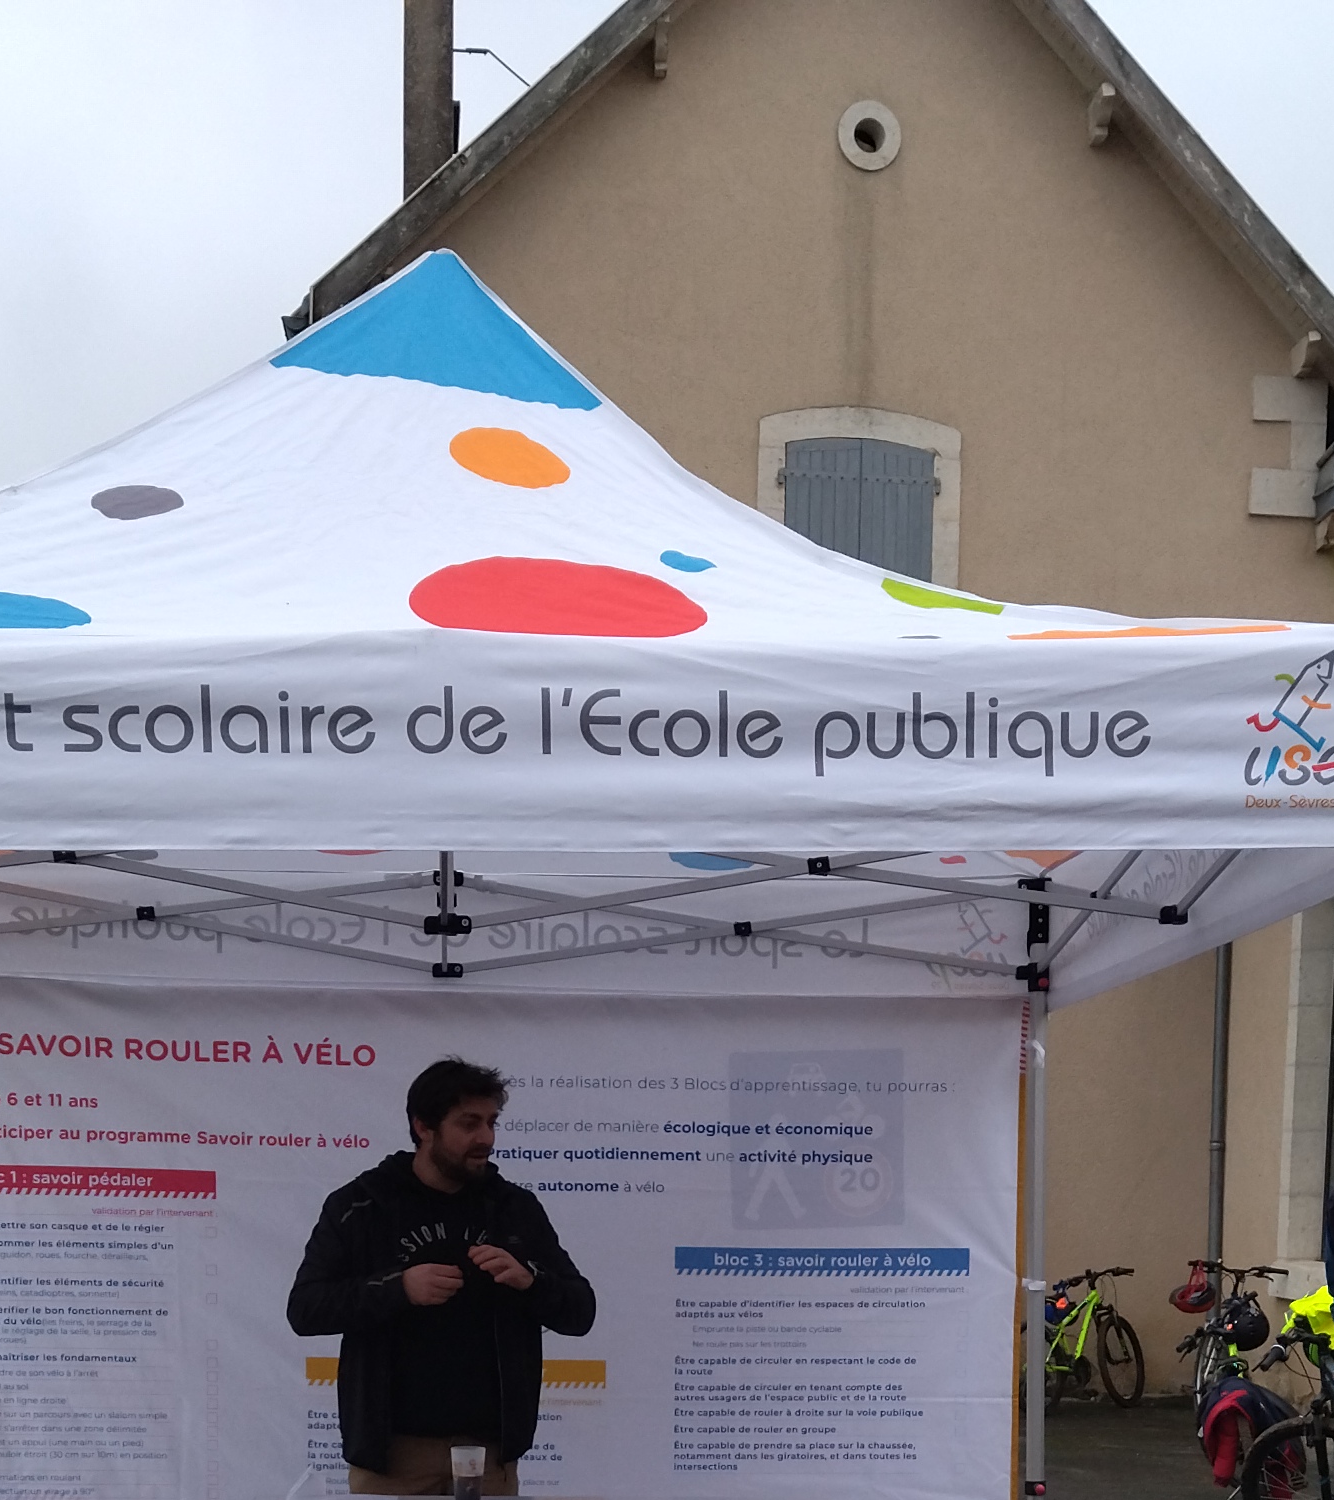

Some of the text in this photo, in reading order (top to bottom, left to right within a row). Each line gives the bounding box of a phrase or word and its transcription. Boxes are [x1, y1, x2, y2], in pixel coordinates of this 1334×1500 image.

[62, 684, 376, 754] scolaire
[406, 685, 508, 754] de
[541, 687, 785, 759] l'Ecole
[814, 692, 1151, 778] publique
[125, 1039, 251, 1062] ROULER
[262, 1035, 283, 1063] À
[294, 1037, 375, 1066] VÉLO
[531, 1075, 947, 1096] la réalisation des 3 Blocs d'apprentissage, tu pourras
[7, 1092, 18, 1106] 6
[24, 1094, 42, 1106] et
[48, 1094, 62, 1107] 11
[69, 1097, 98, 1108] ans
[505, 1119, 570, 1134] déplacer
[574, 1120, 593, 1132] de
[598, 1120, 659, 1133] manière
[664, 1121, 750, 1136] écologique
[755, 1124, 770, 1134] et
[775, 1123, 873, 1138] économique
[59, 1129, 80, 1139] au
[87, 1130, 191, 1144] programme
[197, 1131, 253, 1145] Savoir
[259, 1133, 311, 1147] rouler
[317, 1134, 326, 1147] à
[332, 1134, 369, 1148] vélo
[564, 1147, 701, 1162] quotidiennement
[706, 1153, 738, 1163] une
[739, 1150, 796, 1162] activité
[802, 1150, 873, 1165] physique
[10, 1171, 17, 1184] 1
[32, 1172, 82, 1185] savoir
[88, 1172, 153, 1189] pédaler
[538, 1180, 620, 1193] autonome
[624, 1181, 631, 1192] à
[635, 1181, 664, 1192] vélo
[839, 1167, 881, 1193] 20
[51, 1224, 88, 1232] casque
[92, 1223, 102, 1231] et
[105, 1222, 118, 1231] de
[122, 1223, 131, 1232] le
[134, 1223, 164, 1234] régler
[714, 1253, 931, 1267] bloc 3 savoir rouler à vélo
[676, 1297, 925, 1310] Être capable d'identifier les espaces de circulation
[675, 1309, 714, 1320] adaptés
[738, 1309, 763, 1318] vélos
[674, 1462, 737, 1470] intersections
